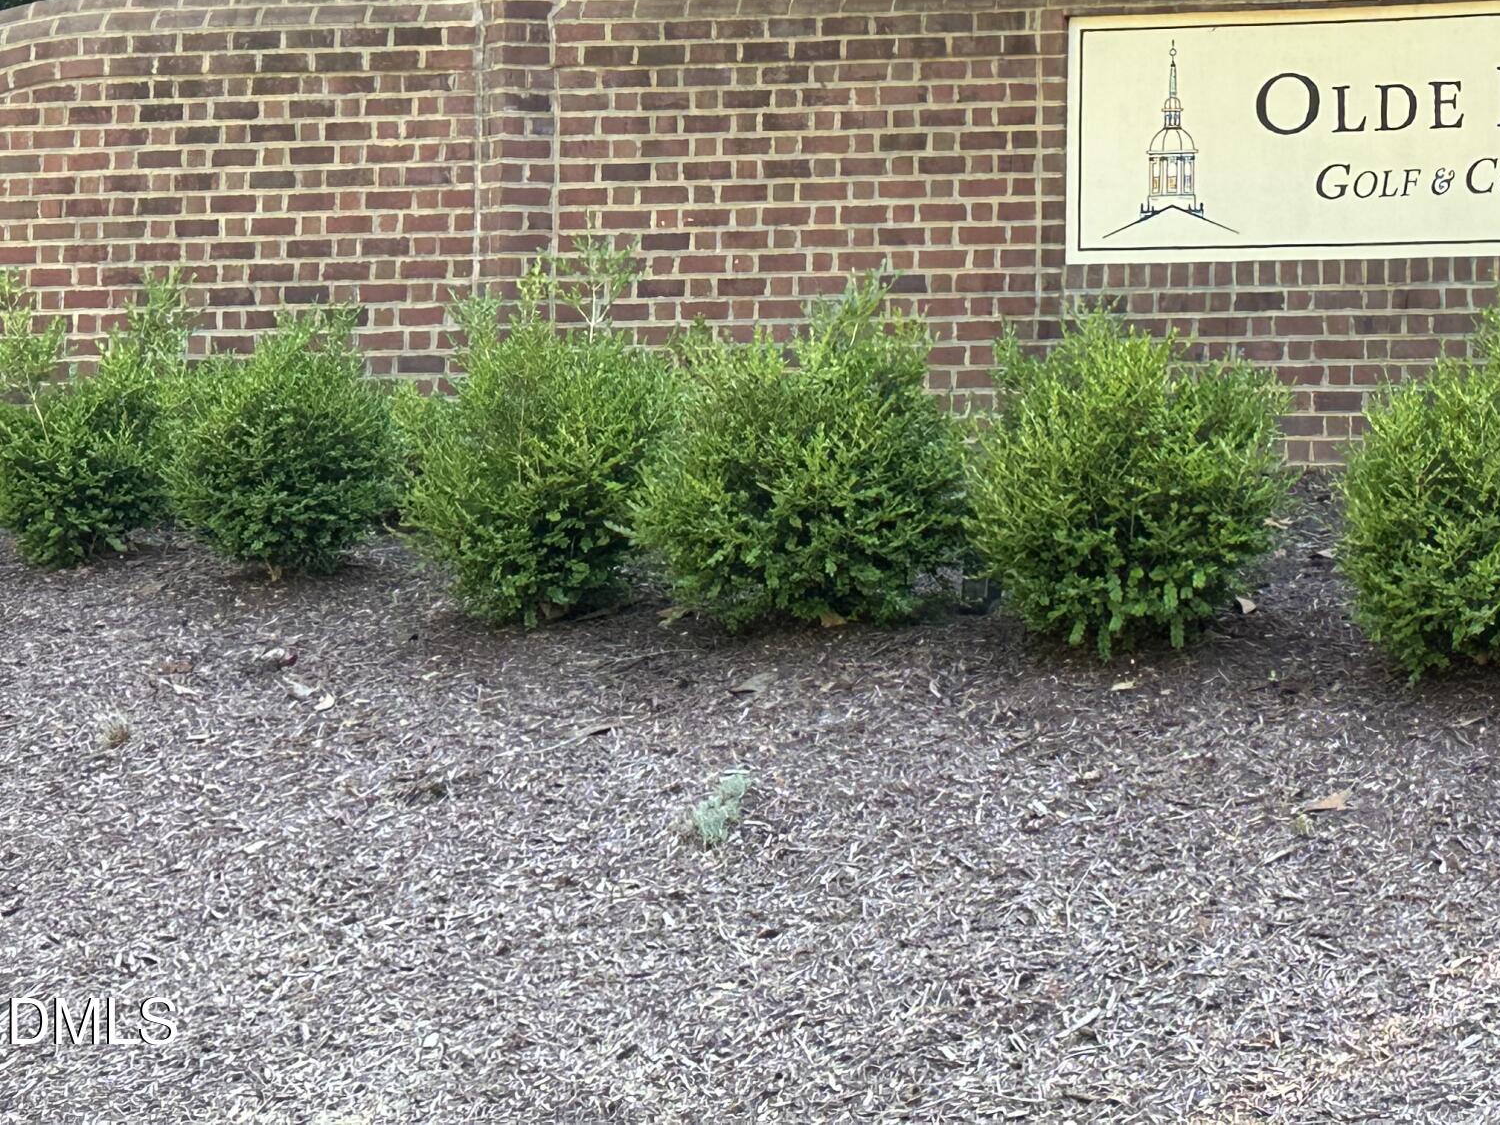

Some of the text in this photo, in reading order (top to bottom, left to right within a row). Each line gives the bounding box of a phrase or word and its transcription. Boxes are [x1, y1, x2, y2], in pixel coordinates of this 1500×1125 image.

[1256, 73, 1464, 135] OLDE
[1316, 164, 1421, 199] GOLF
[1432, 168, 1455, 195] &
